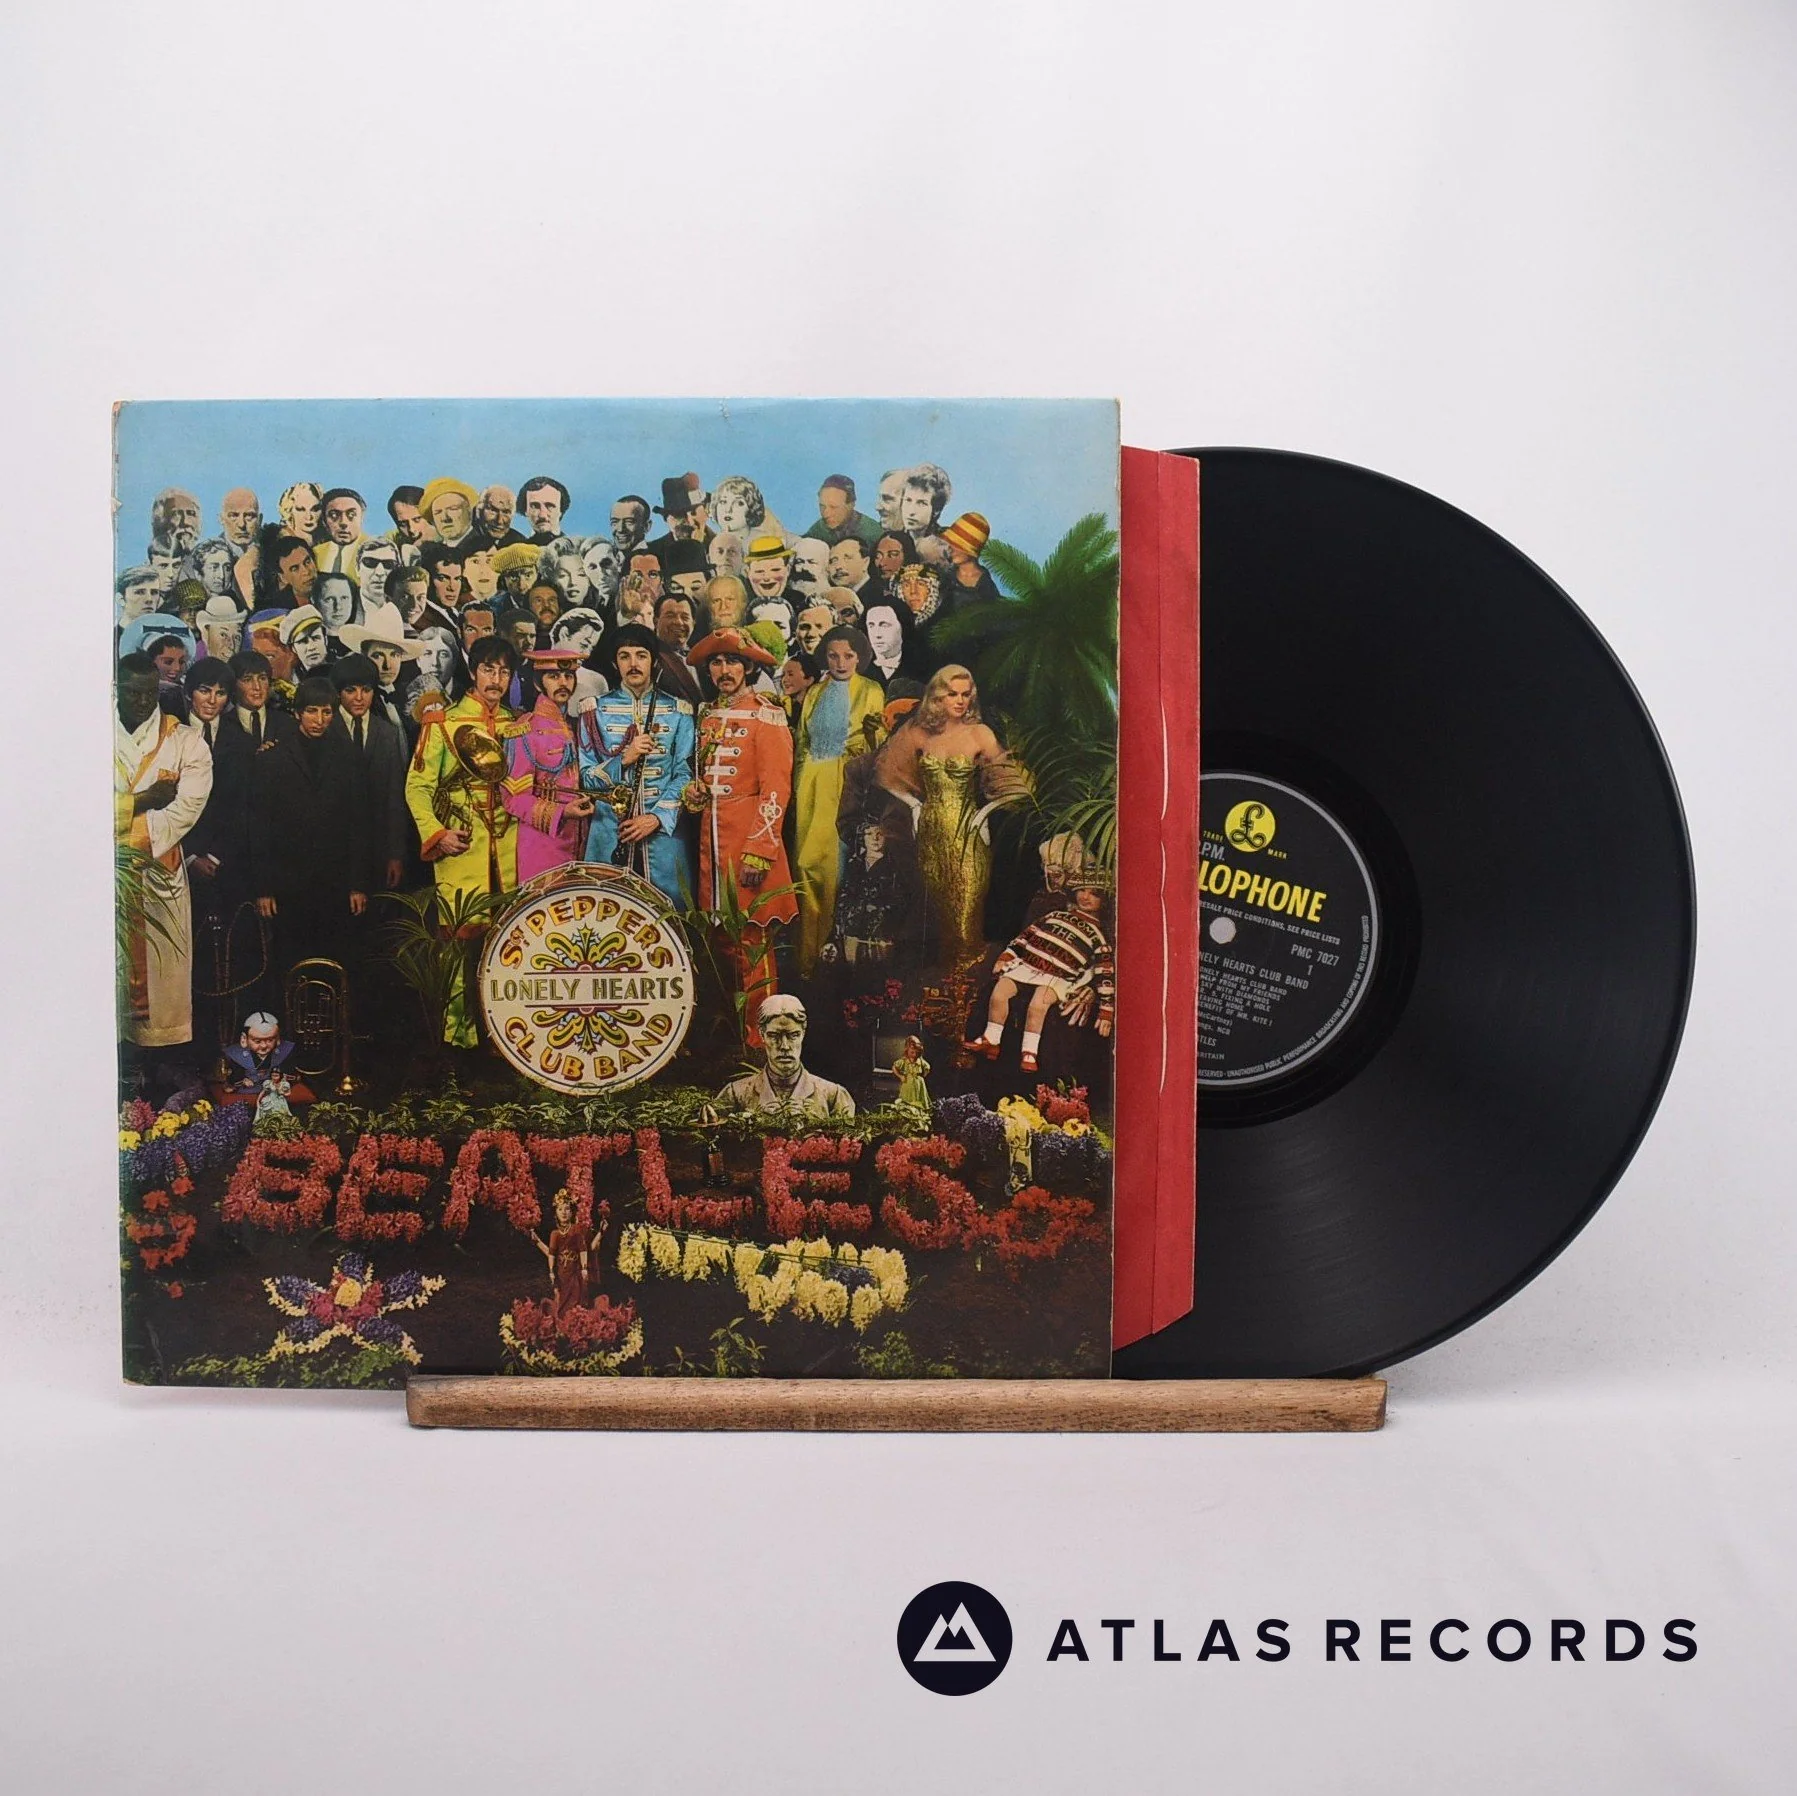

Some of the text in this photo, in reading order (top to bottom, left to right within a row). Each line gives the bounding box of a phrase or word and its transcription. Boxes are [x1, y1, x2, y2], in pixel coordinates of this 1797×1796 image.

[1051, 924, 1077, 942] THE
[1223, 907, 1243, 919] PRICE
[1287, 924, 1300, 934] SEE
[1301, 928, 1321, 939] PRICE
[1291, 944, 1340, 967] PMC 7027
[1222, 957, 1256, 975] HEARTS
[1259, 968, 1281, 982] CLUB
[1285, 975, 1309, 990] BAND
[1222, 972, 1247, 985] HEARTS
[1249, 980, 1267, 990] CLUB
[1307, 965, 1314, 976] 1
[490, 976, 684, 1001] LONELY HEARTS
[1216, 985, 1234, 995] WITH
[1236, 991, 1270, 1005] DIAMONDS
[1219, 979, 1238, 989] FROM
[1253, 988, 1281, 1001] FRIENDS
[1225, 1008, 1235, 1016] OF
[1253, 1003, 1272, 1013] HOLE
[1264, 1057, 1282, 1069] PUBLIC
[1339, 997, 1350, 1009] AND
[505, 1013, 673, 1081] CLUB BAND
[1198, 1052, 1225, 1060] RITAIN
[217, 1127, 980, 1250] BEATLES
